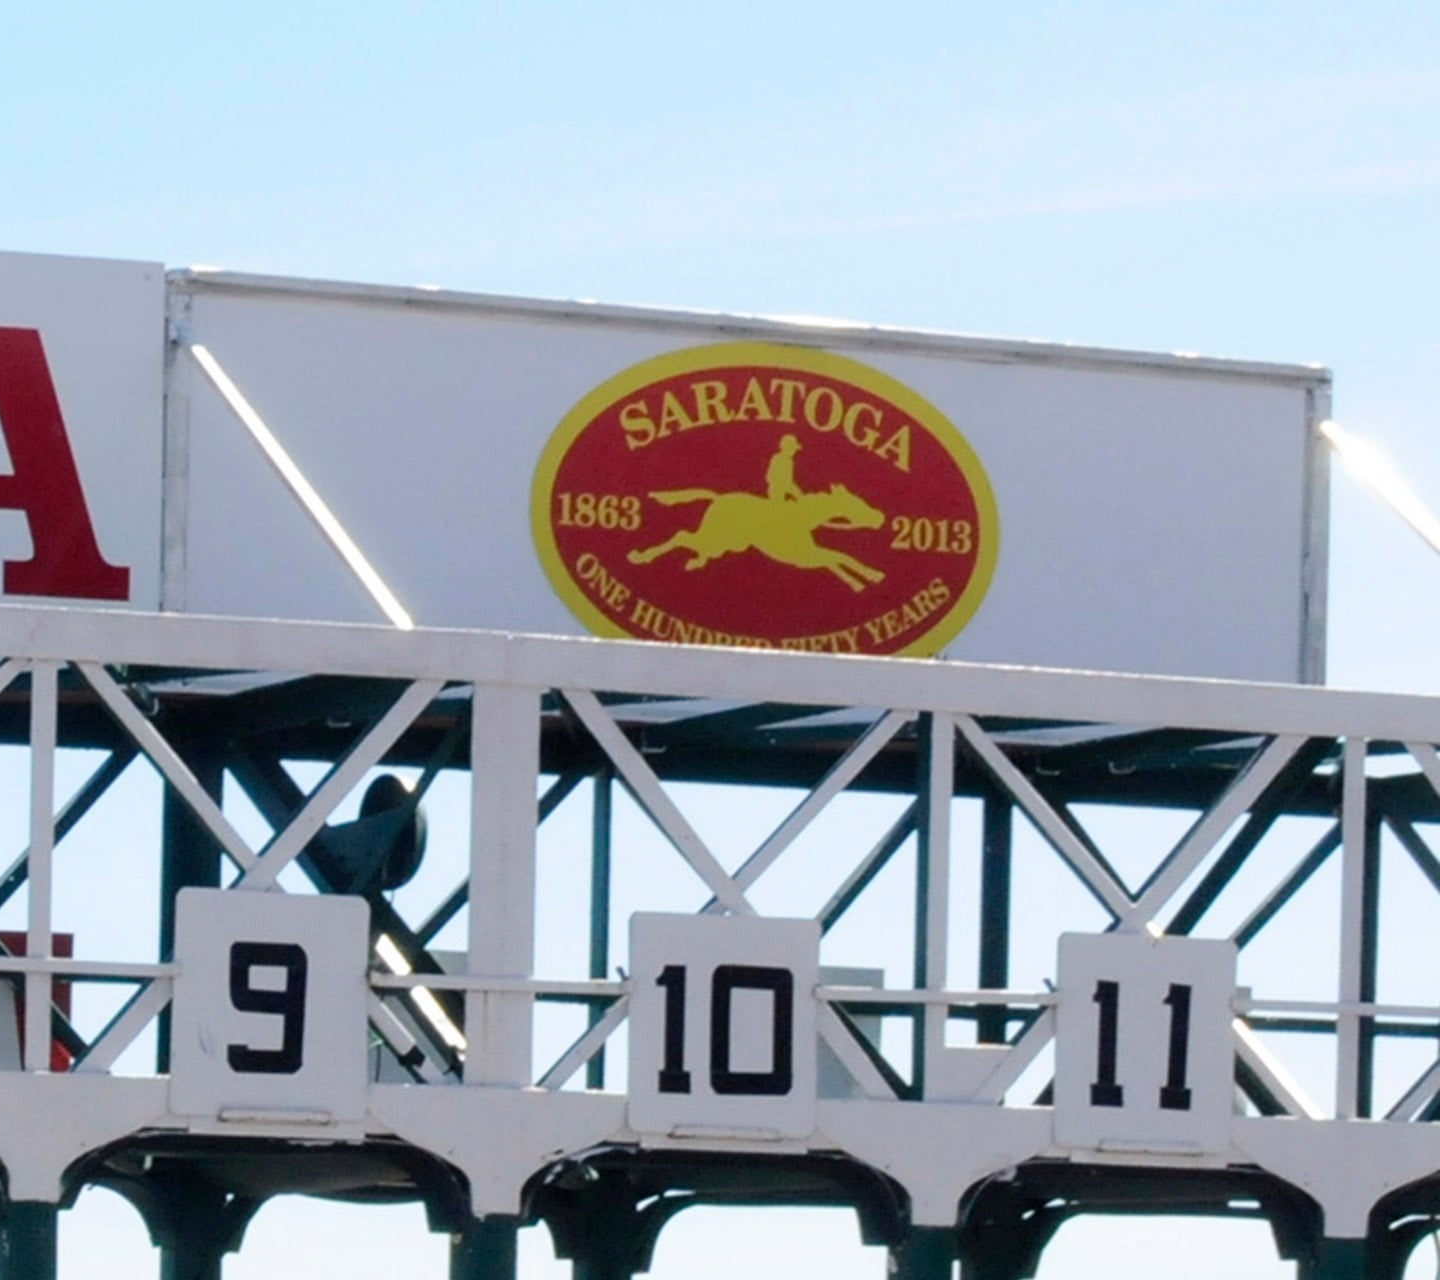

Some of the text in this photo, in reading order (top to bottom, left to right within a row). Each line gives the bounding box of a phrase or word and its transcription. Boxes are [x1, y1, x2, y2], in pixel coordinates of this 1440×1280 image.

[619, 378, 911, 472] SARATOGA
[557, 493, 641, 531] 1863
[891, 516, 973, 554] 2013
[576, 553, 631, 612] ONE
[864, 578, 950, 645] YEARS
[227, 941, 308, 1075] 9
[655, 964, 794, 1096] 10
[1090, 980, 1192, 1111] 11
